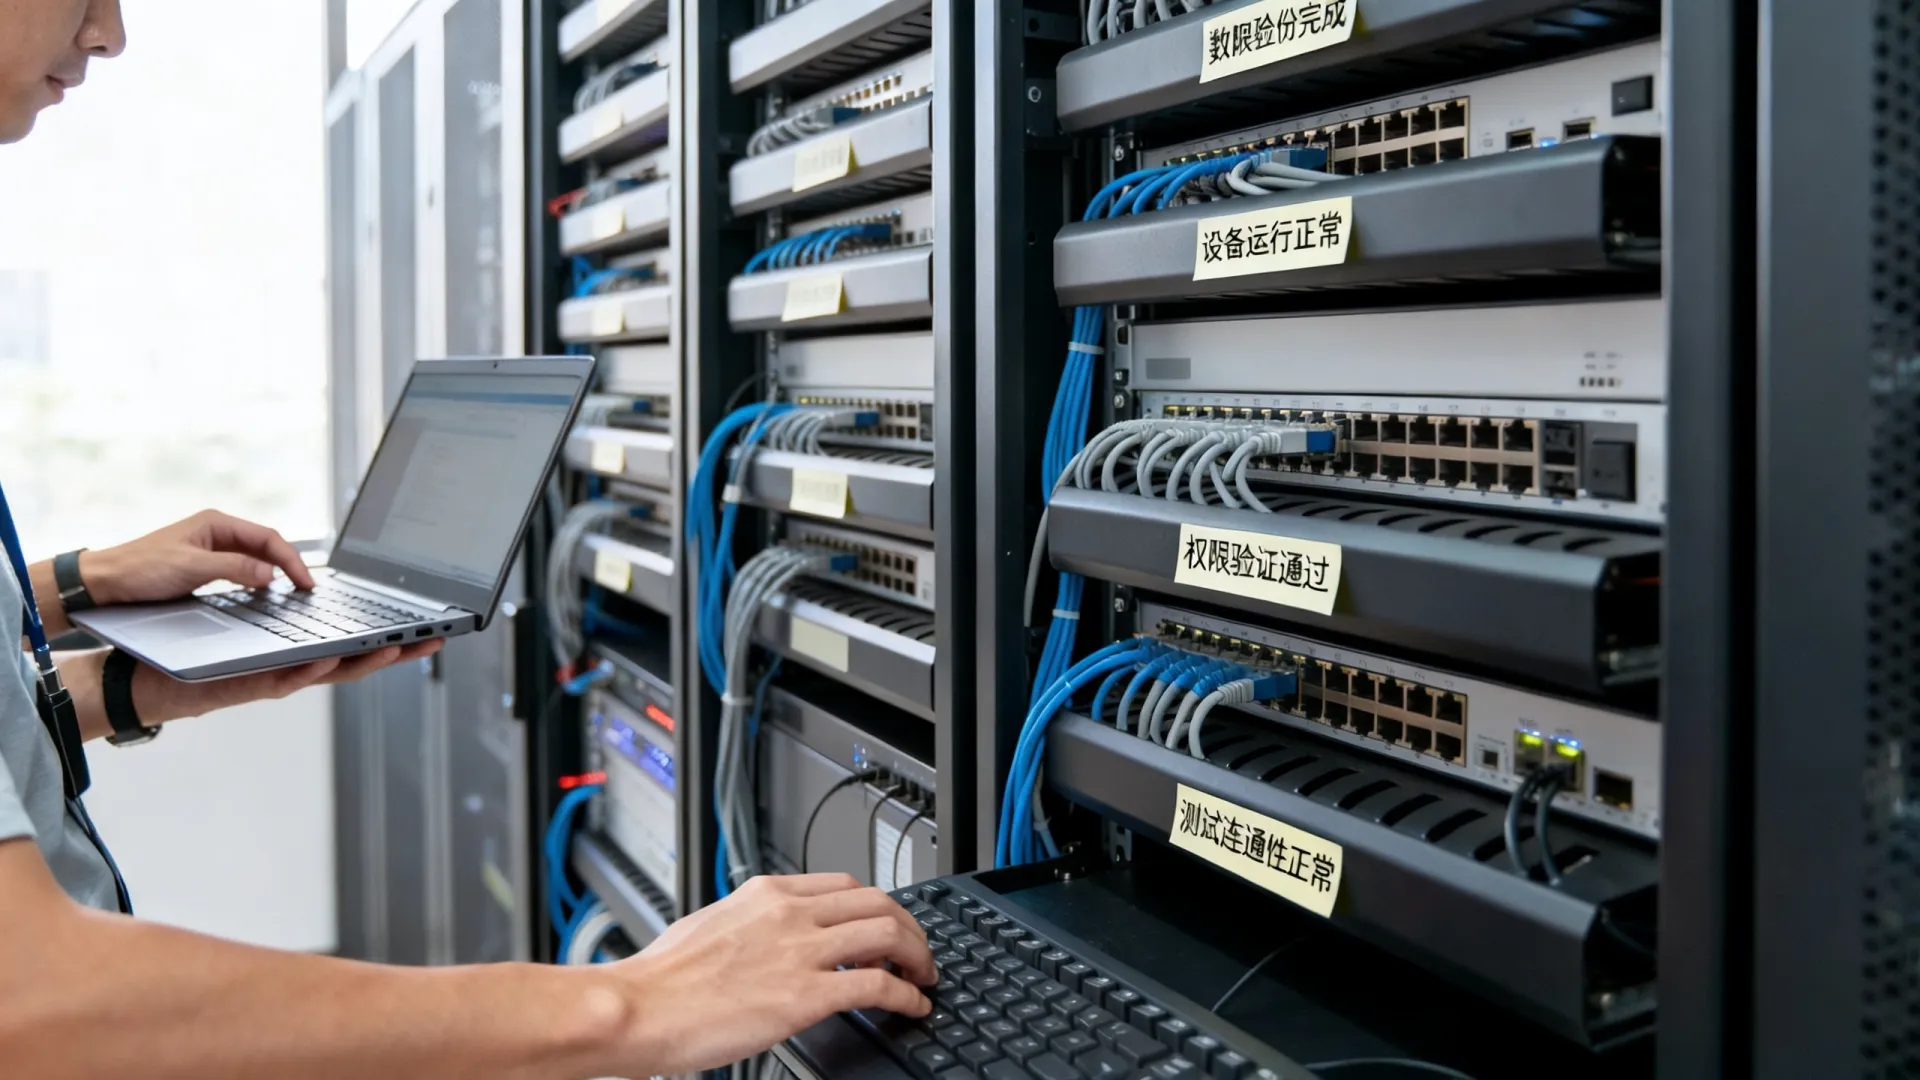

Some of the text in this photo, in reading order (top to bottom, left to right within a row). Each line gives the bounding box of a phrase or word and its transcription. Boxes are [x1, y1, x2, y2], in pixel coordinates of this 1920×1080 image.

[1202, 210, 1342, 263] 设备运行正常
[1183, 533, 1330, 592] 权限验证通过
[1179, 798, 1335, 893] 测试连通性正常
